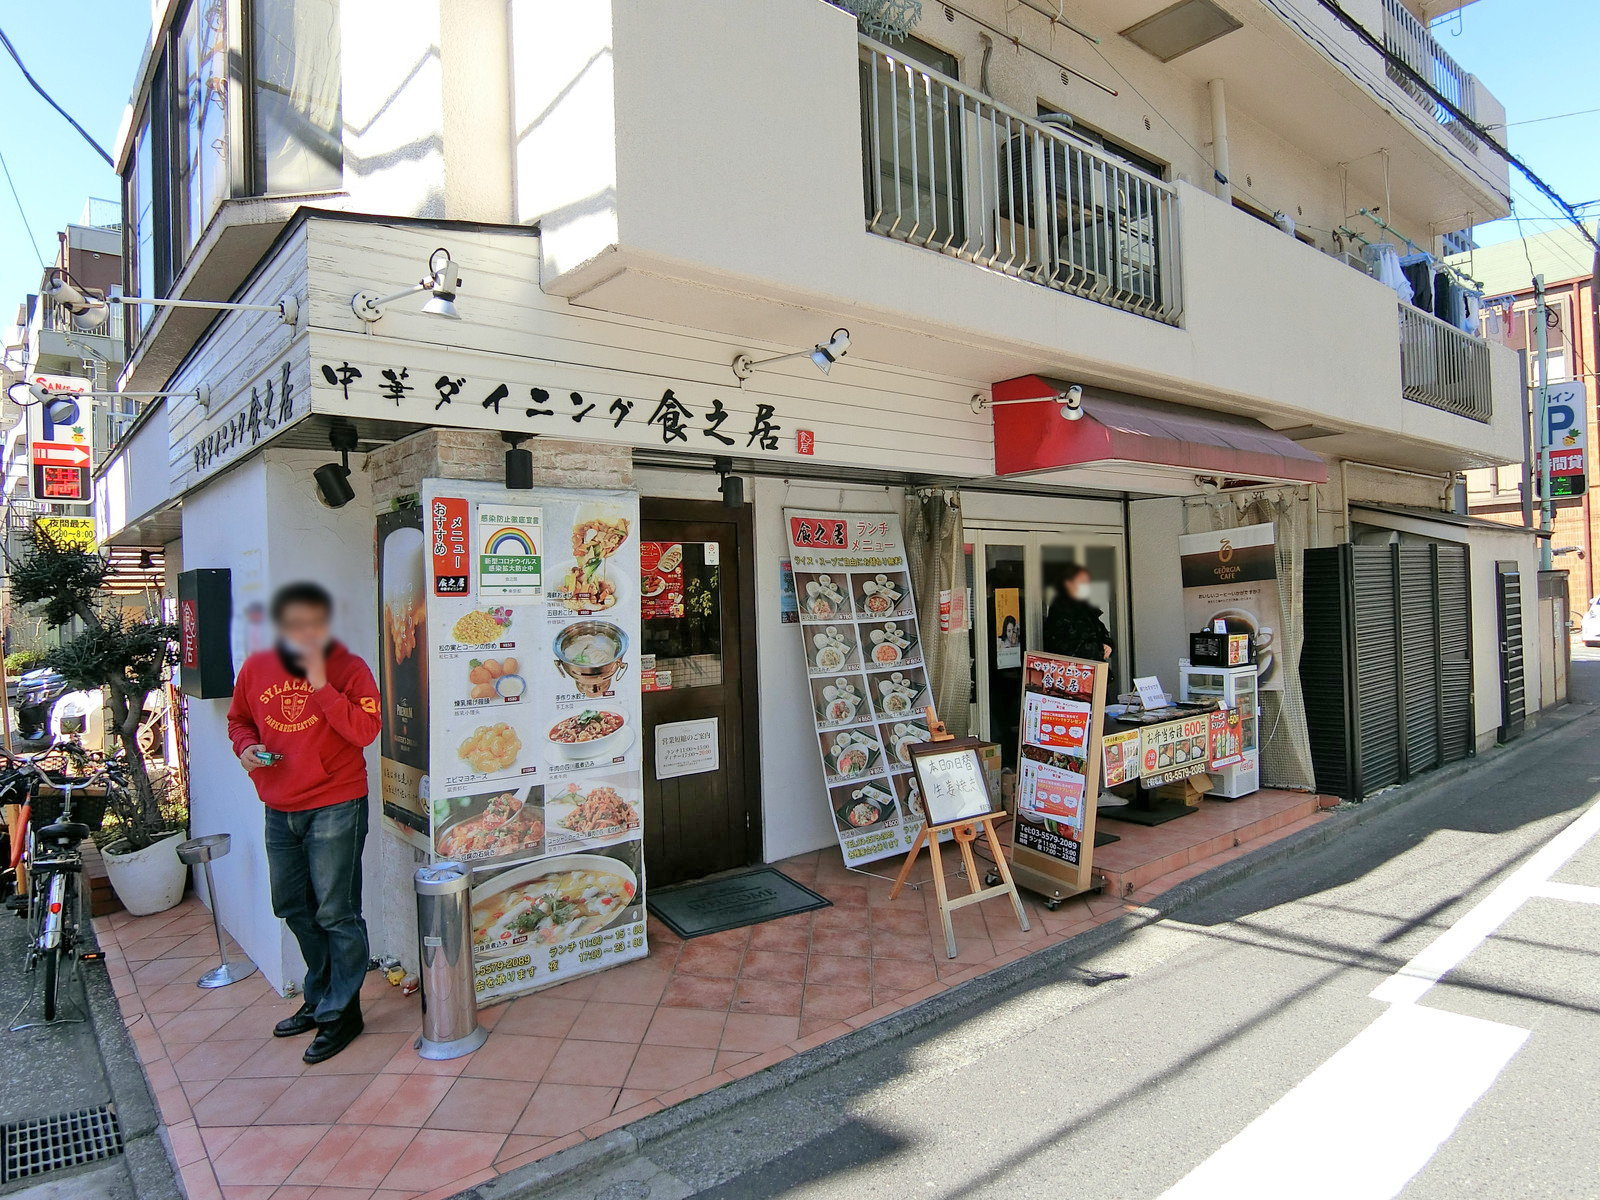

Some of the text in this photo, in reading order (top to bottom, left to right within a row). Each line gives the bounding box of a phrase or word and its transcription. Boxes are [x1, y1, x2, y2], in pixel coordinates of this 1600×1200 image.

[1547, 405, 1575, 445] P
[49, 519, 90, 528] 夜間最大
[434, 503, 447, 556] おすすめ
[857, 521, 889, 536] ランチ
[451, 516, 465, 569] メニュー
[852, 540, 895, 552] メニュー
[1220, 572, 1236, 580] CAFE
[1042, 673, 1079, 692] 食之居
[446, 773, 488, 784] エビマヨネーズ
[1164, 763, 1206, 783] 03-5579-2089
[1029, 835, 1042, 844] ランチ
[549, 943, 577, 959] ランチ
[474, 954, 531, 978] -5579-2089
[548, 960, 559, 972] 夜
[475, 967, 536, 993] 会を承ります
